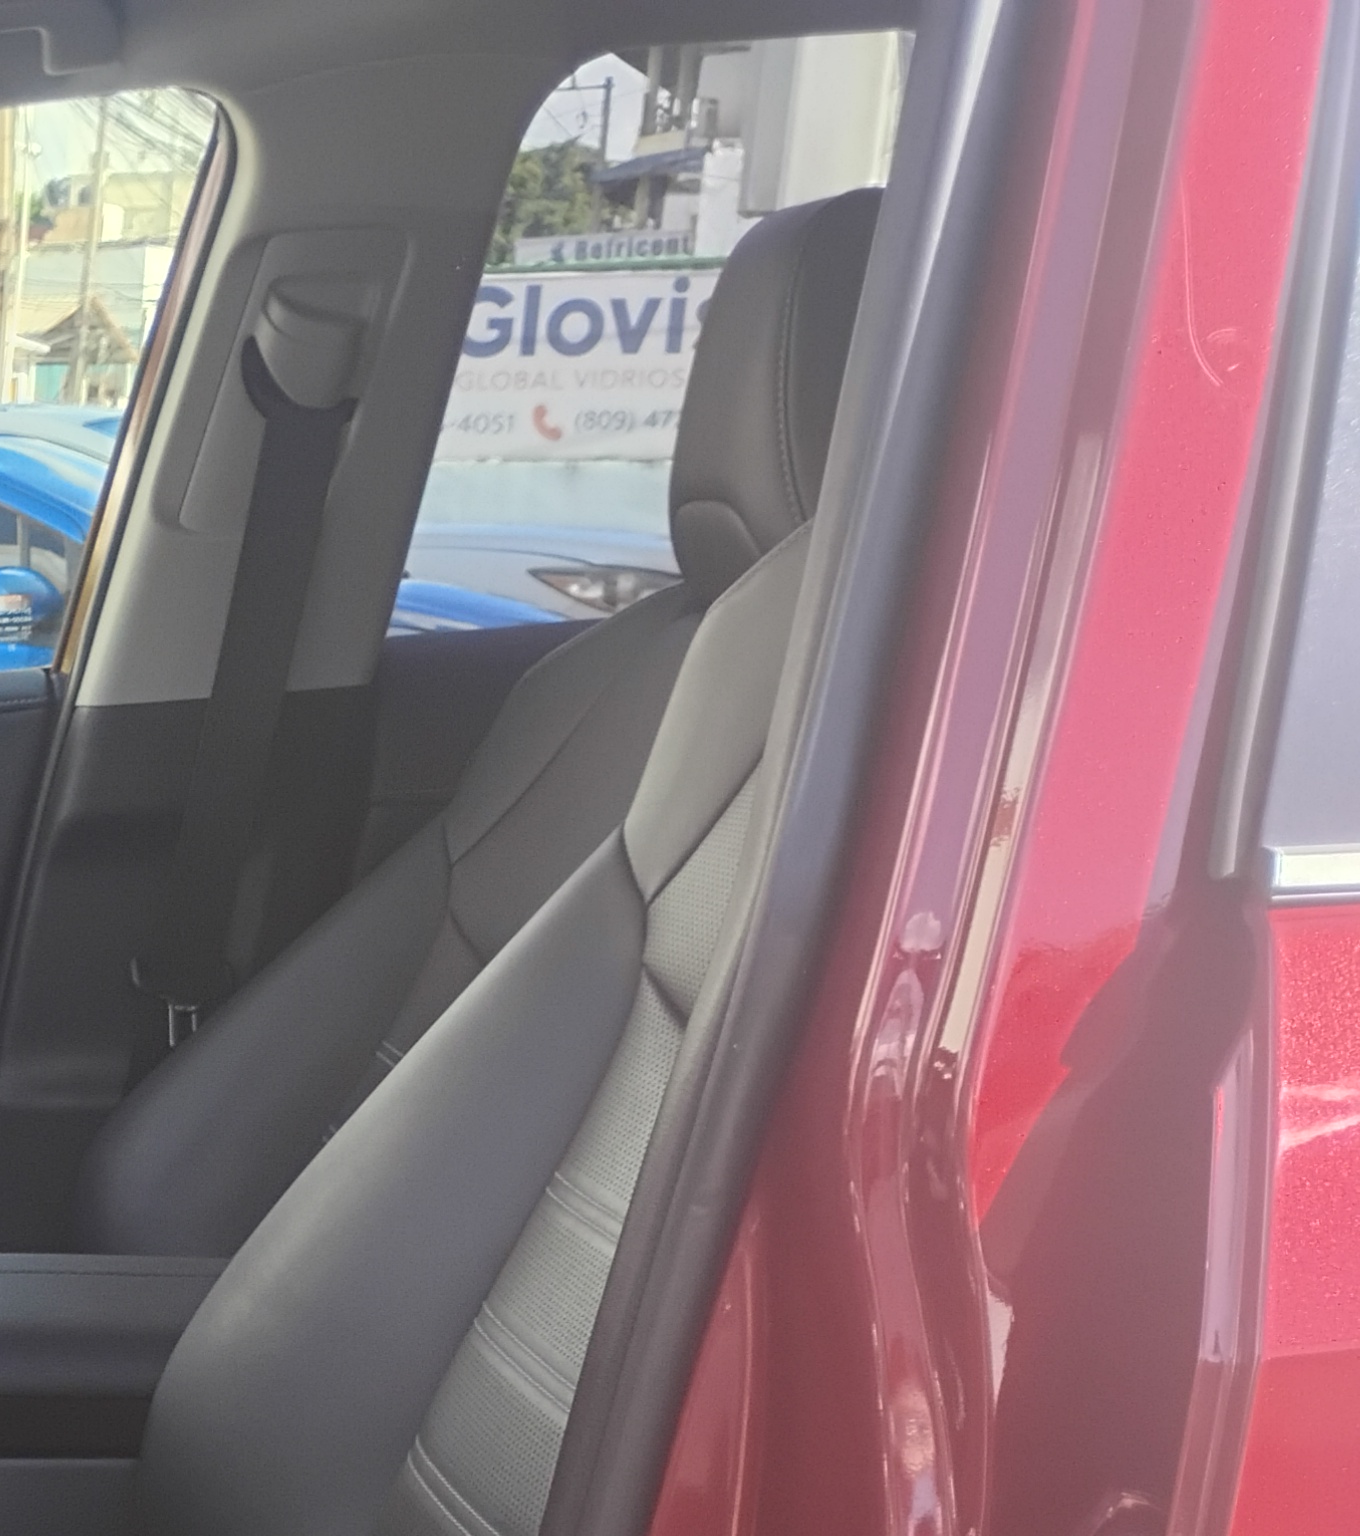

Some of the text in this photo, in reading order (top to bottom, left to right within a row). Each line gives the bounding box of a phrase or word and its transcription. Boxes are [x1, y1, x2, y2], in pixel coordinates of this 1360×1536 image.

[457, 367, 686, 392] GLOBAL VIDRIOS
[441, 407, 681, 435] -4051 (809) 47
